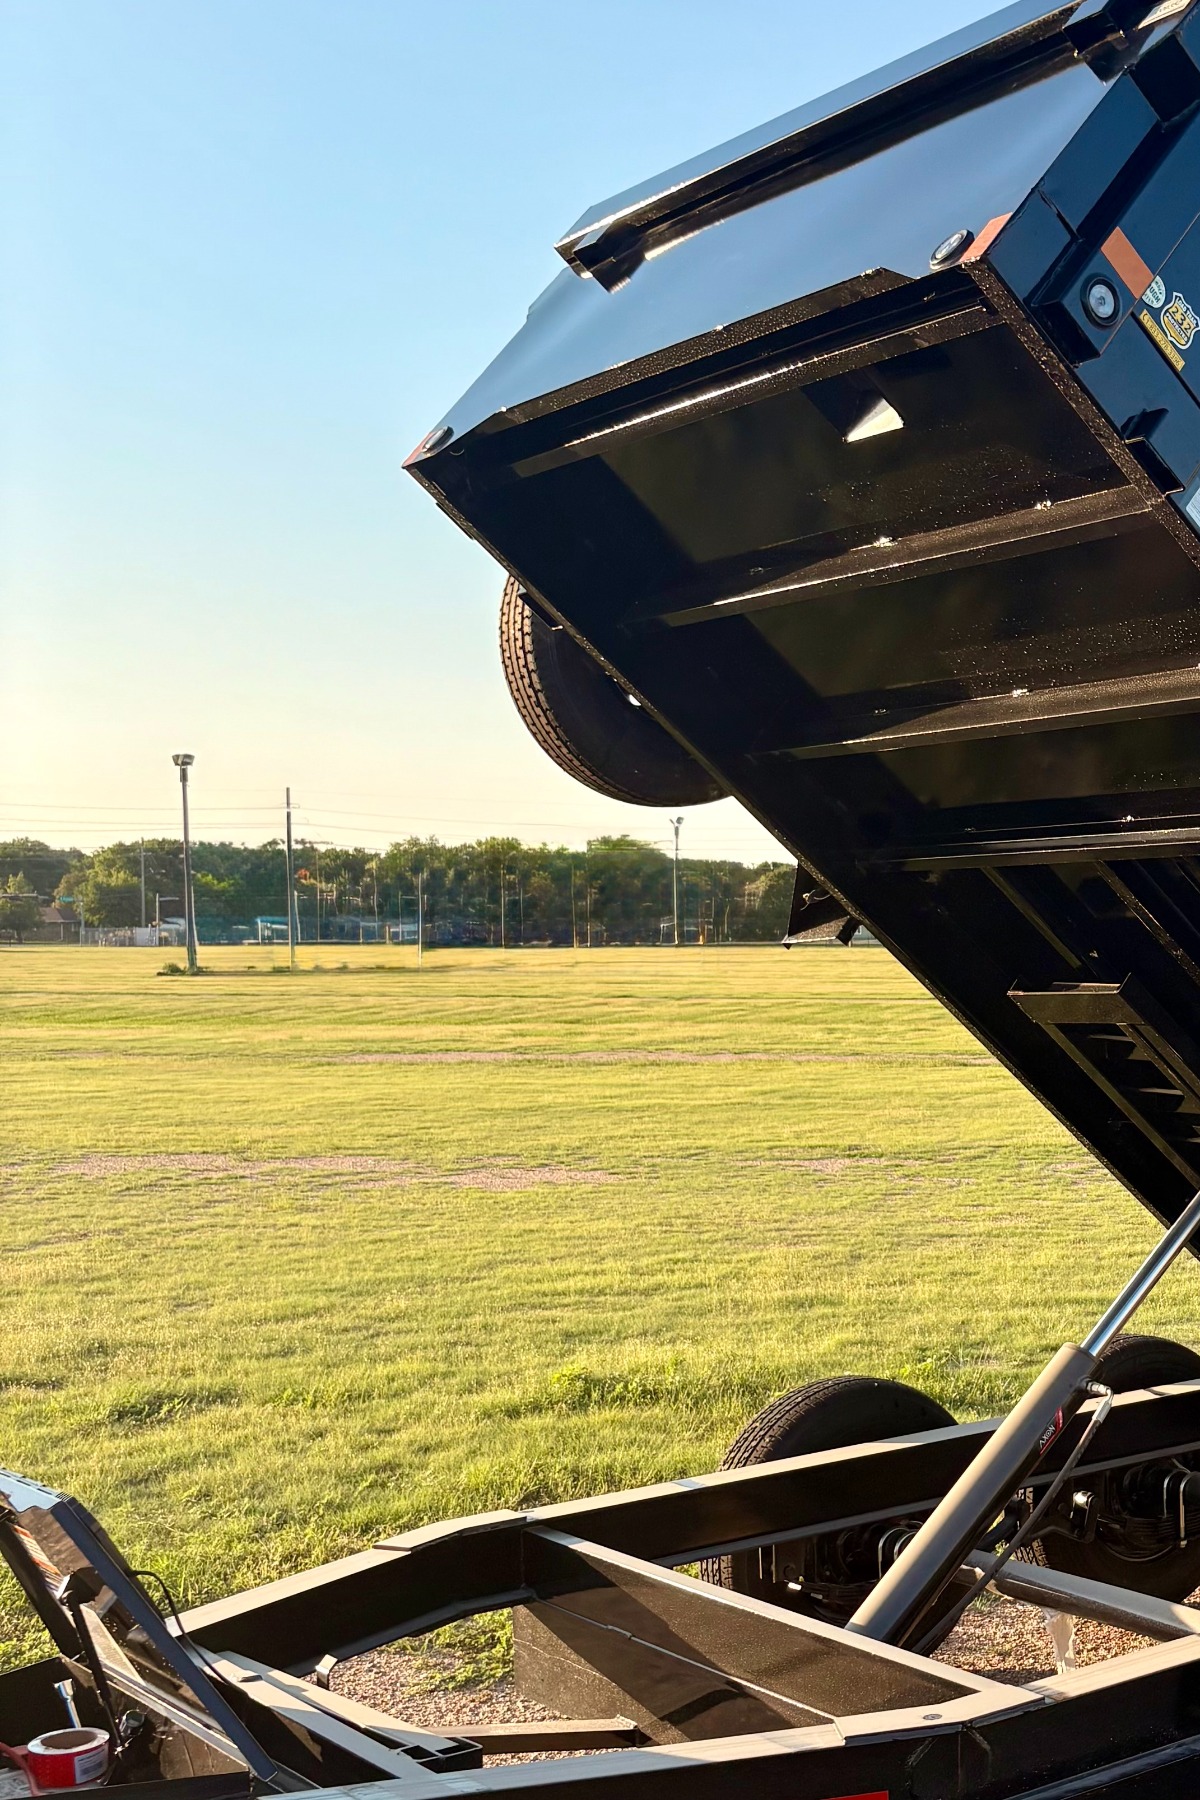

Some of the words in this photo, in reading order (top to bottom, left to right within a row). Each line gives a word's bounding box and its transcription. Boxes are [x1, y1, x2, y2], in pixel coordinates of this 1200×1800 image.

[1176, 296, 1187, 312] LOAD
[1166, 312, 1188, 342] PROTECTED
[1172, 305, 1192, 334] 232
[1039, 1424, 1056, 1449] AXON
